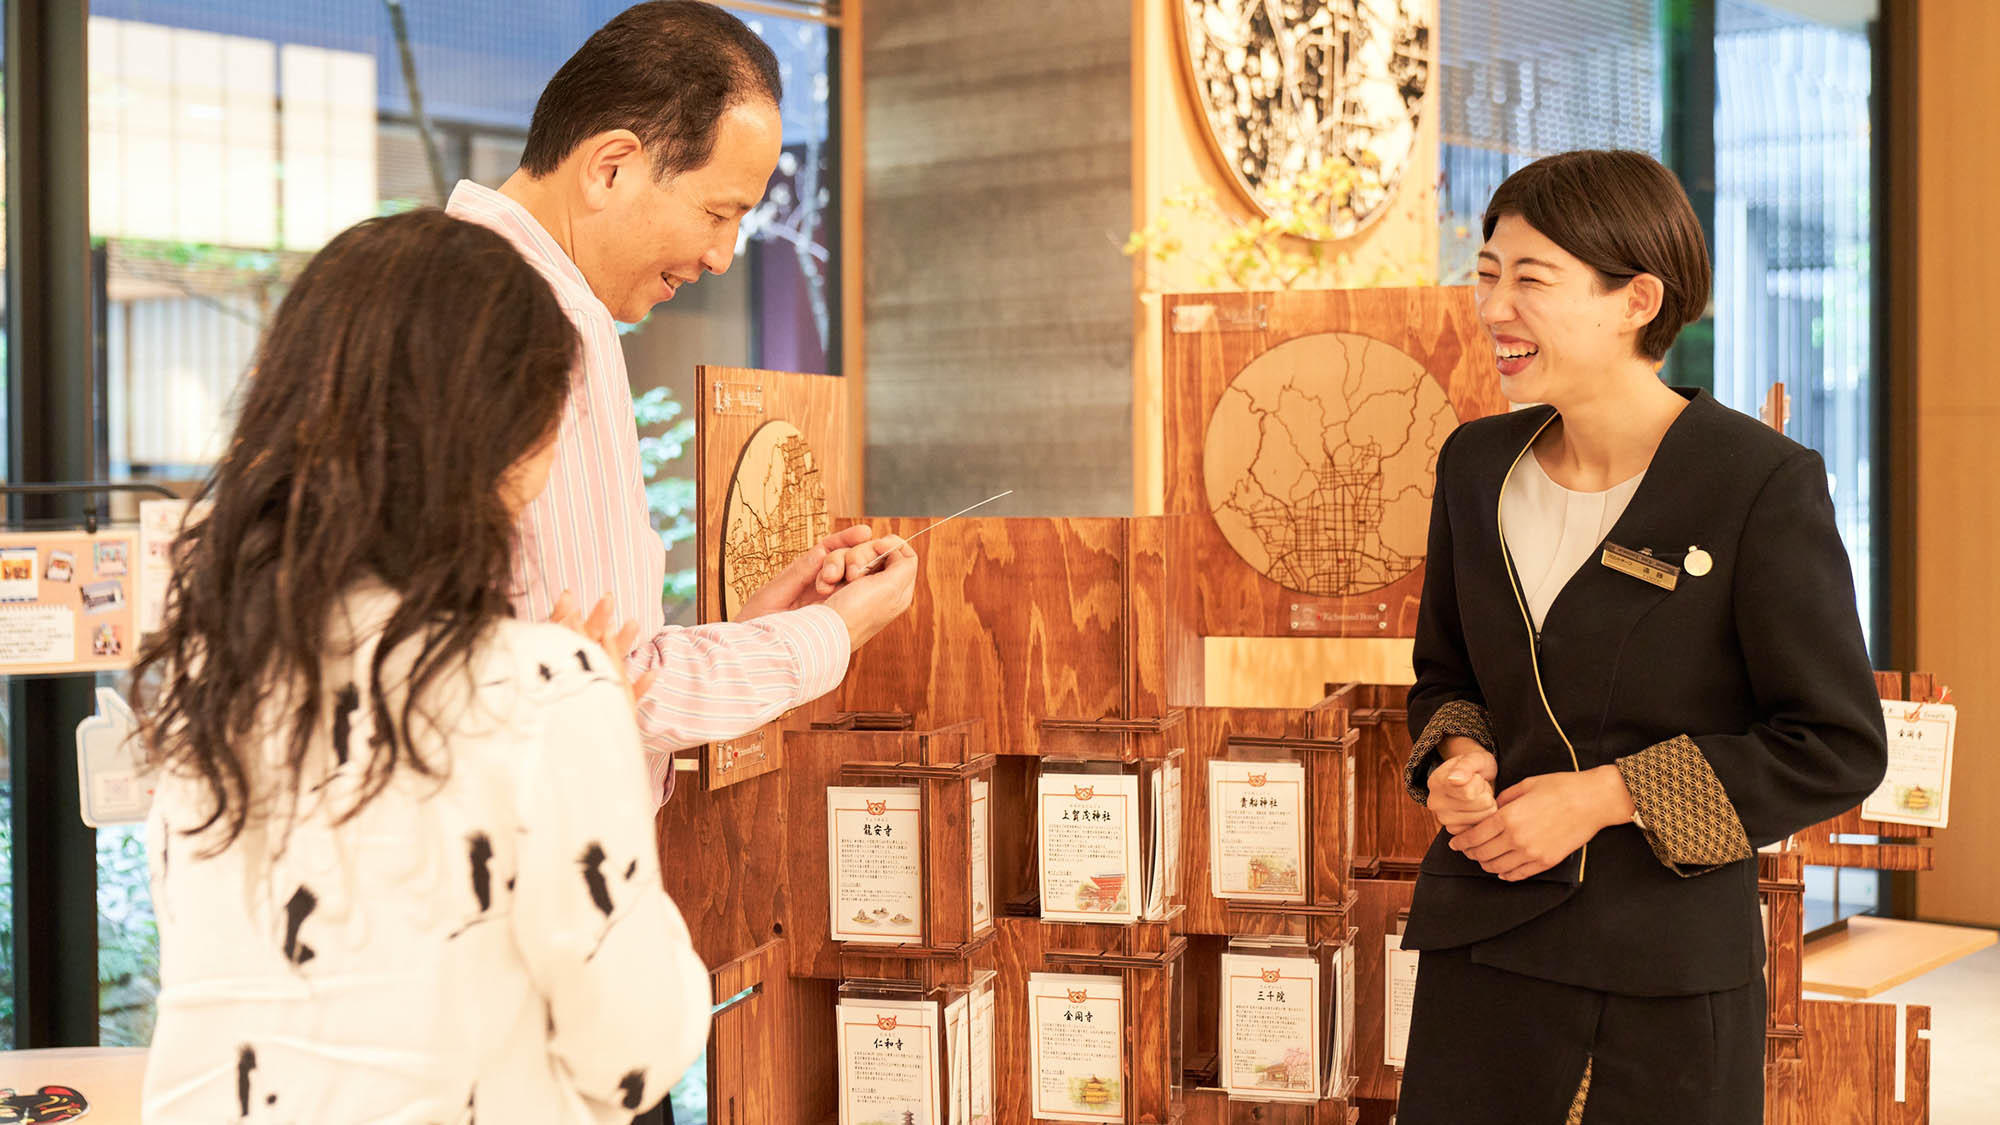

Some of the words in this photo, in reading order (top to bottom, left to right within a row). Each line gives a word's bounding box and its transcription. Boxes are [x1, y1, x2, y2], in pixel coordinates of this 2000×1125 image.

[1240, 797, 1278, 808] 貴船神社
[1062, 809, 1111, 822] 上賀茂神社
[863, 823, 893, 837] 龍安寺
[1257, 990, 1286, 1003] 三千院
[873, 1037, 904, 1051] 仁和寺
